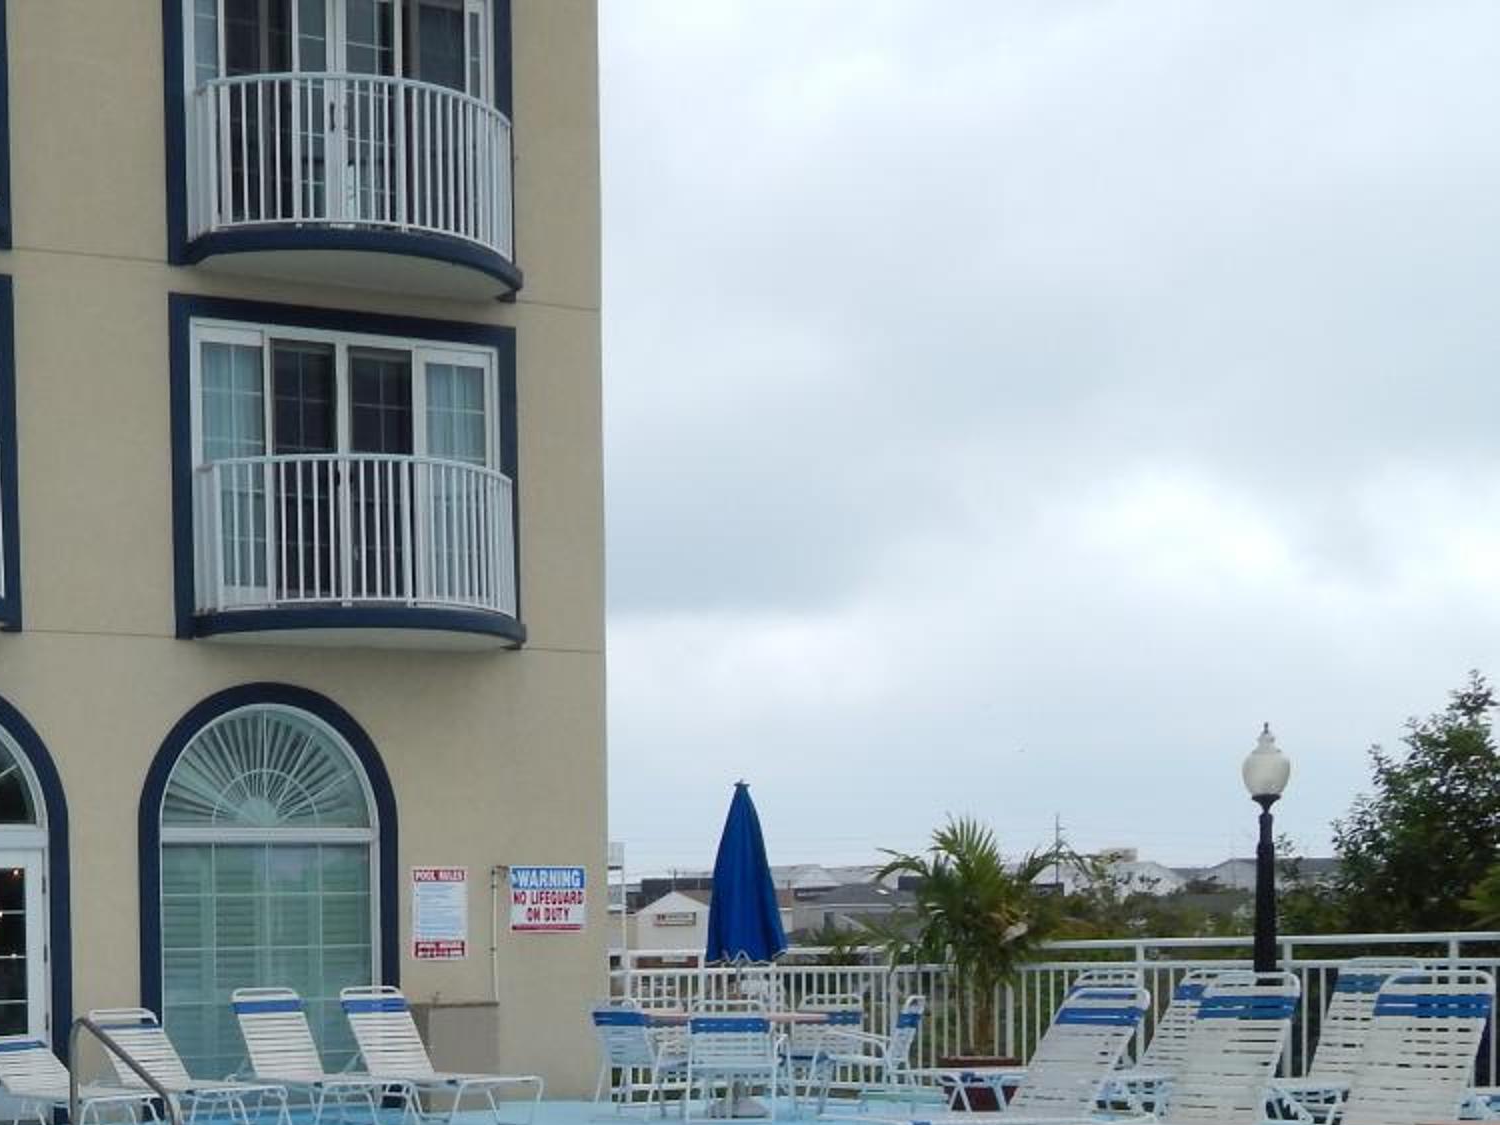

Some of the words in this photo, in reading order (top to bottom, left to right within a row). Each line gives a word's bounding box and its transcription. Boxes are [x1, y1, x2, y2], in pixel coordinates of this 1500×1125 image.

[517, 869, 581, 888] WARNING
[513, 891, 527, 905] NO
[531, 891, 583, 905] LIFEGUARD
[526, 907, 541, 922] ON
[545, 907, 570, 922] DUTY
